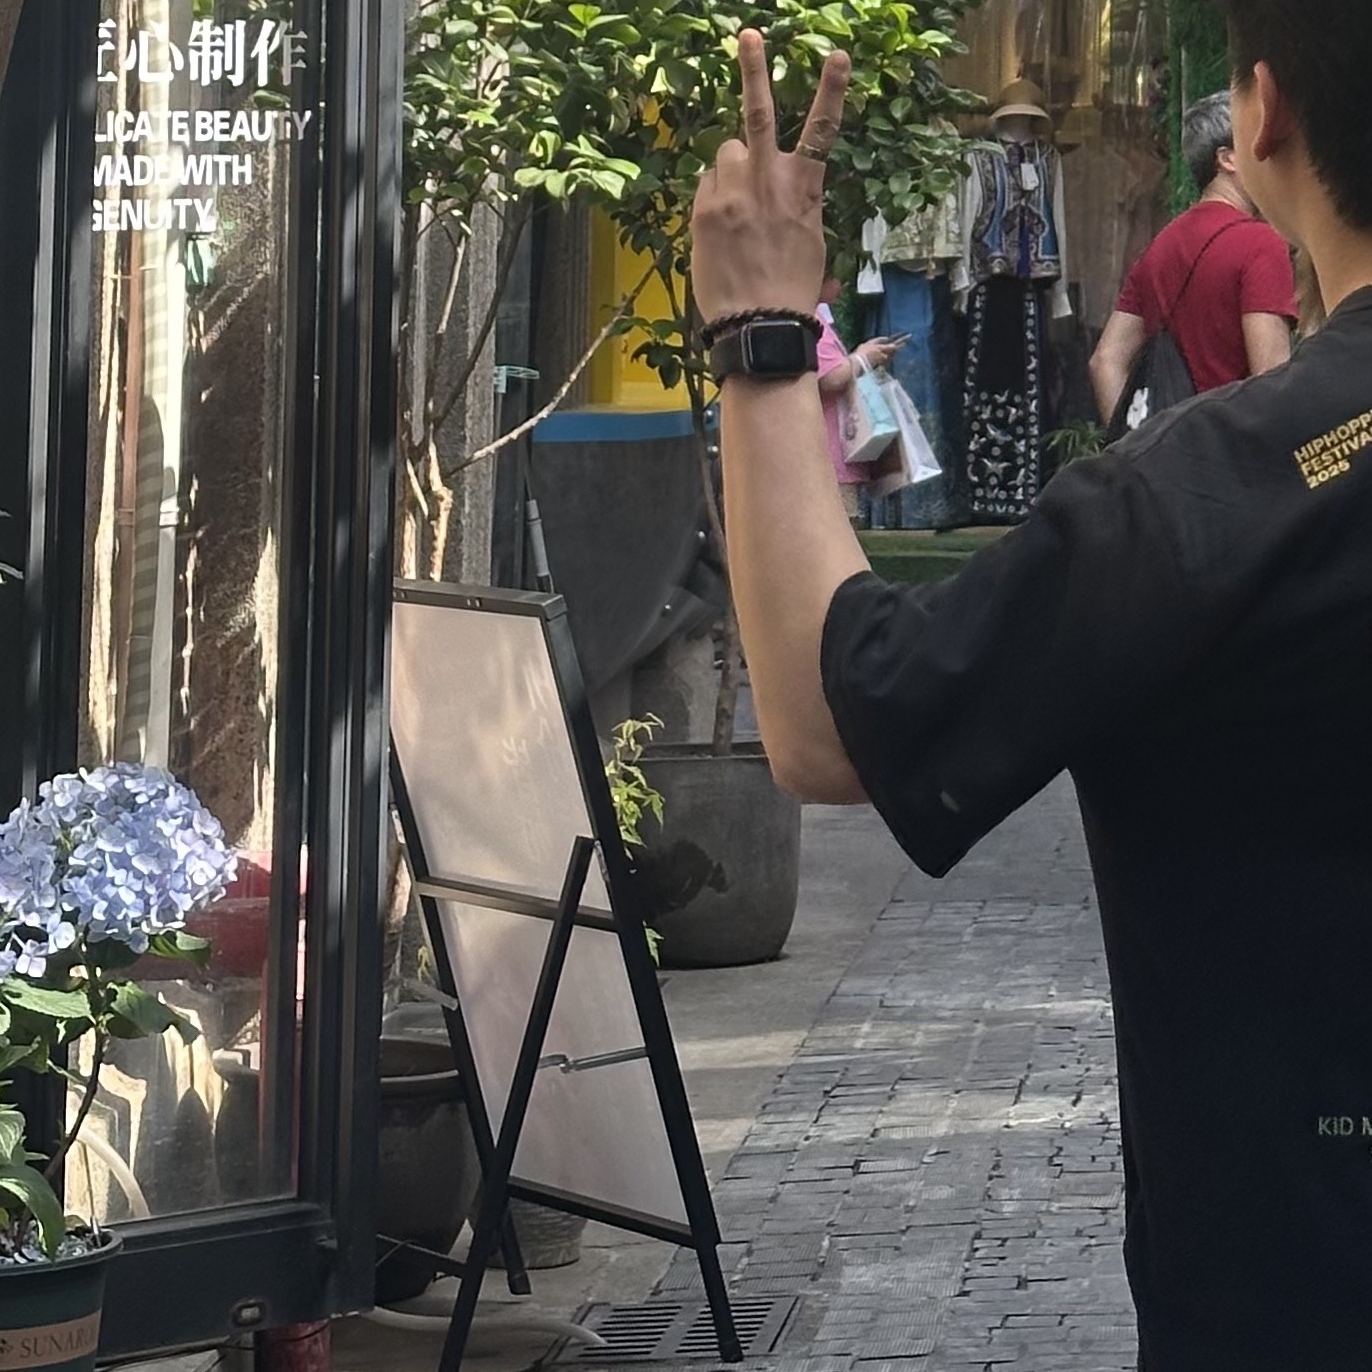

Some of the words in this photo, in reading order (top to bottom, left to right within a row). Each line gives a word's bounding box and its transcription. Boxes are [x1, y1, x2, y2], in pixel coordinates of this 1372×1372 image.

[194, 109, 312, 142] BEAUTY
[176, 153, 253, 186] WITH
[1306, 459, 1351, 490] 2025
[1317, 1116, 1354, 1137] KID
